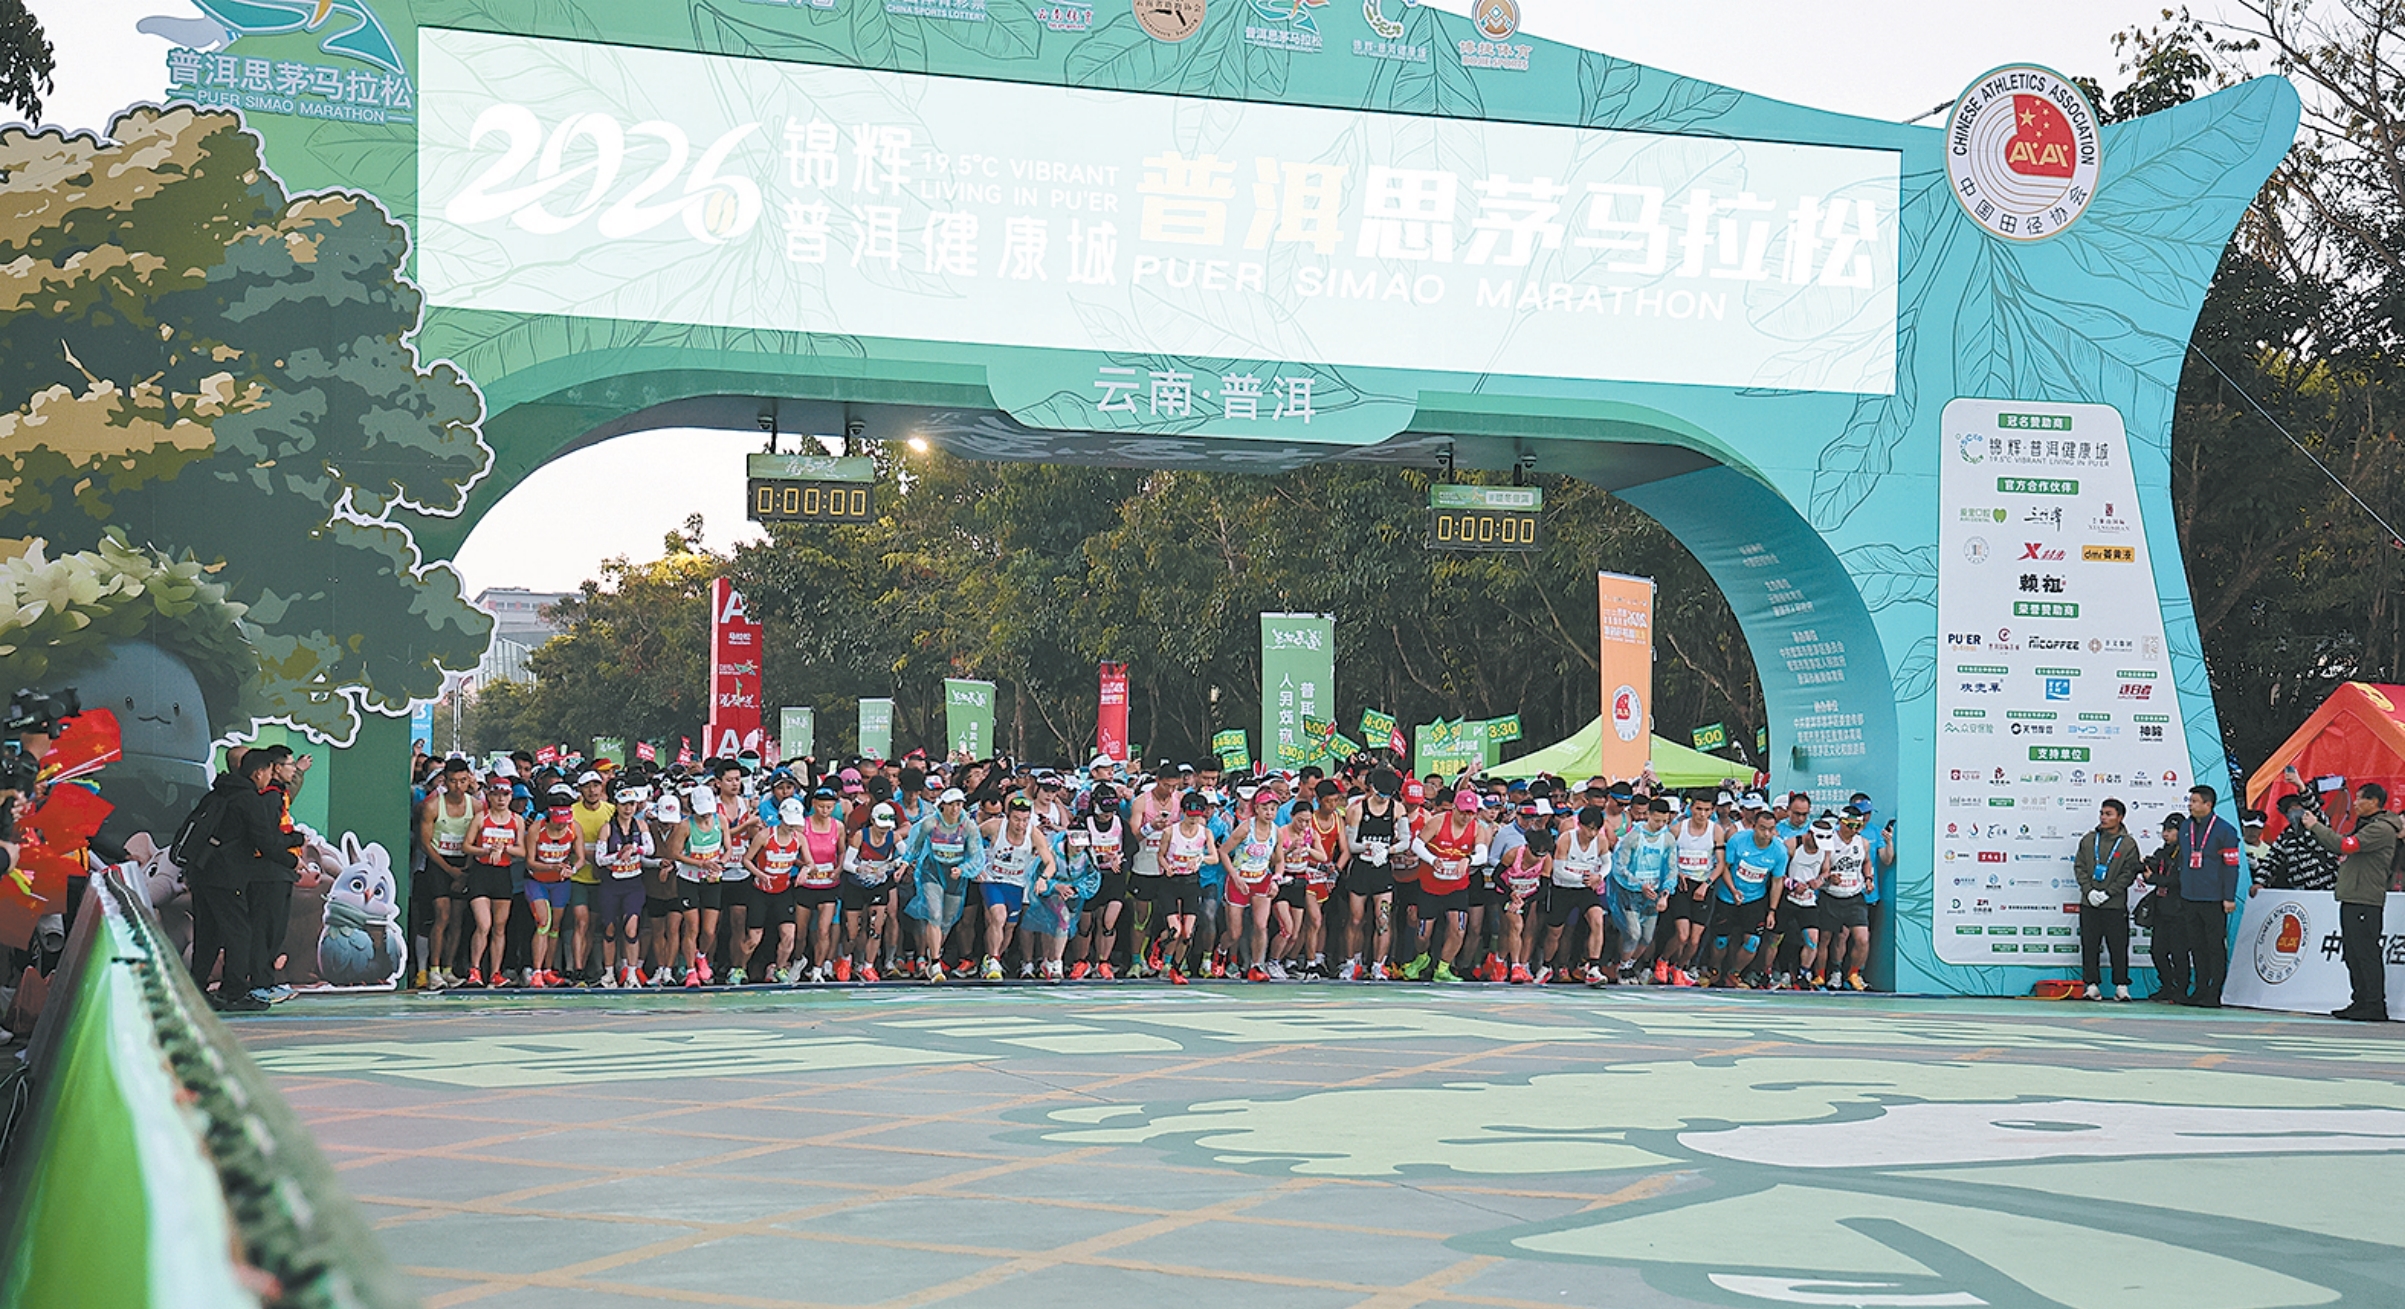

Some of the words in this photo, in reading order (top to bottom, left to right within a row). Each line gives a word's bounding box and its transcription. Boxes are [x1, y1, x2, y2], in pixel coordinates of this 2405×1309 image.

[886, 4, 913, 15] CHINA
[913, 6, 947, 17] SPORTS
[948, 9, 986, 21] LOTTERY
[1245, 26, 1322, 48] 普洱思茅马拉松
[168, 50, 413, 110] 普洱思茅马拉松
[245, 97, 294, 112] SIMAO
[300, 103, 386, 122] MARATHON
[1952, 97, 1983, 156] CHINESE
[1980, 73, 2047, 103] ATHLETICS
[2048, 84, 2095, 166] ASSOCIATION
[783, 115, 912, 197] 锦辉
[445, 103, 762, 244] 2026
[1009, 158, 1120, 187] VIBRANT
[920, 178, 1001, 205] LIVING
[1013, 185, 1039, 208] IN
[1049, 188, 1119, 214] PU'ER
[1960, 177, 2087, 236] 中国田径协会
[1135, 150, 1879, 290] 普洱思茅马拉松
[781, 196, 1118, 287] 普洱健康城
[1132, 254, 1265, 294] PUER
[1295, 264, 1447, 305] SIMAO
[1475, 277, 1728, 322] MARATHON
[1094, 367, 1317, 425] 云南·普洱
[2015, 456, 2046, 465] VIBRANT
[2048, 458, 2075, 466] LIVING
[757, 486, 866, 516] 0:00:00
[2004, 480, 2072, 493] 官方合作伙伴
[1437, 515, 1535, 543] 0:00:00
[1364, 713, 1393, 733] 4:00
[1488, 720, 1518, 738] 3:30
[1693, 729, 1723, 746] 5:00
[2037, 749, 2083, 760] 支持单位
